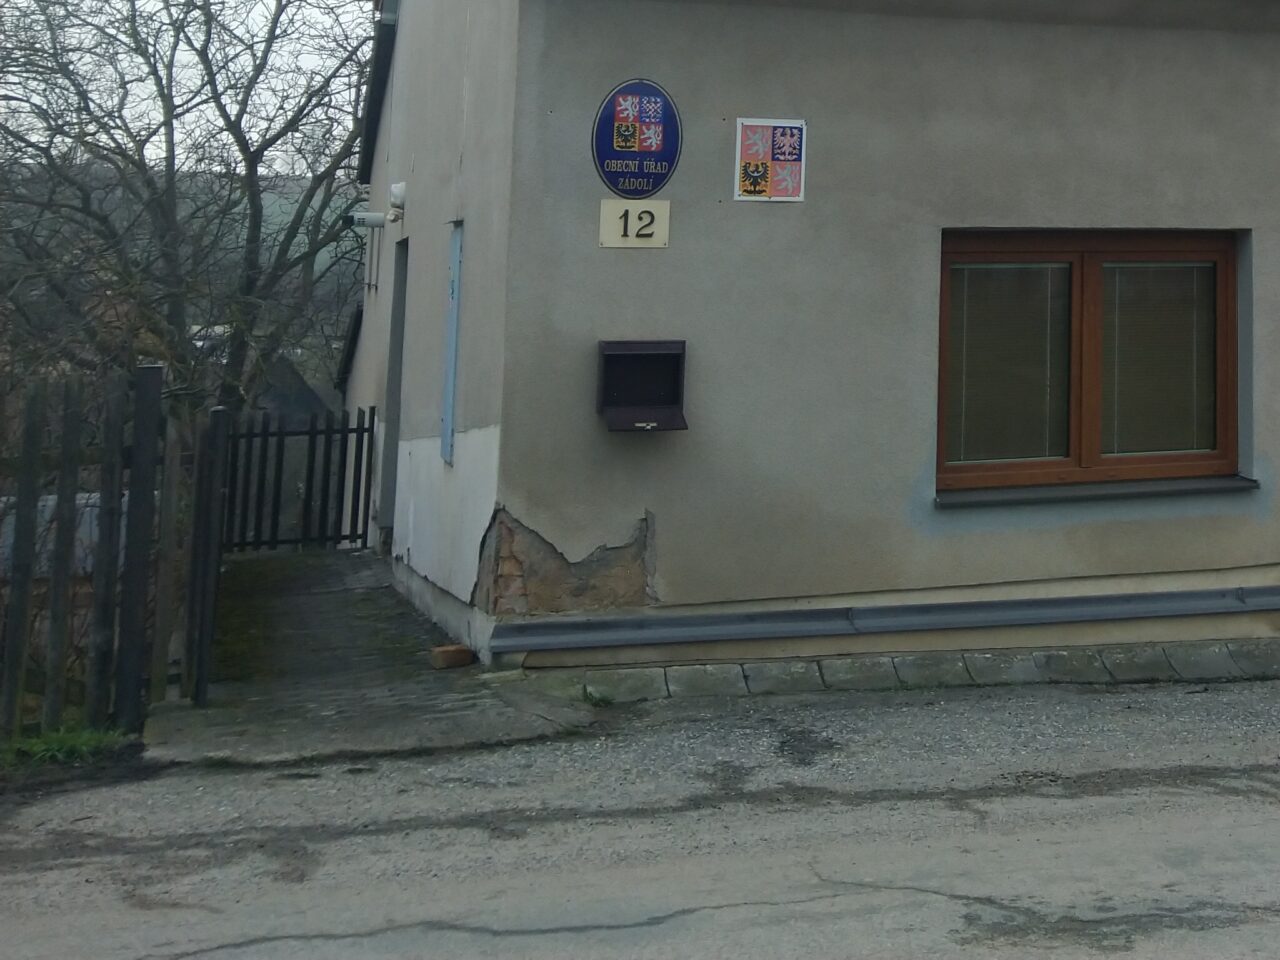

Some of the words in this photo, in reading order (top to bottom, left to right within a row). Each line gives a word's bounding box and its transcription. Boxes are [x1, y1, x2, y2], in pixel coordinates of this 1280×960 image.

[604, 157, 640, 172] OBECNÍ
[643, 158, 669, 173] ÚŘAD
[618, 175, 654, 190] ZÁDOLÍ
[618, 208, 655, 238] 12
